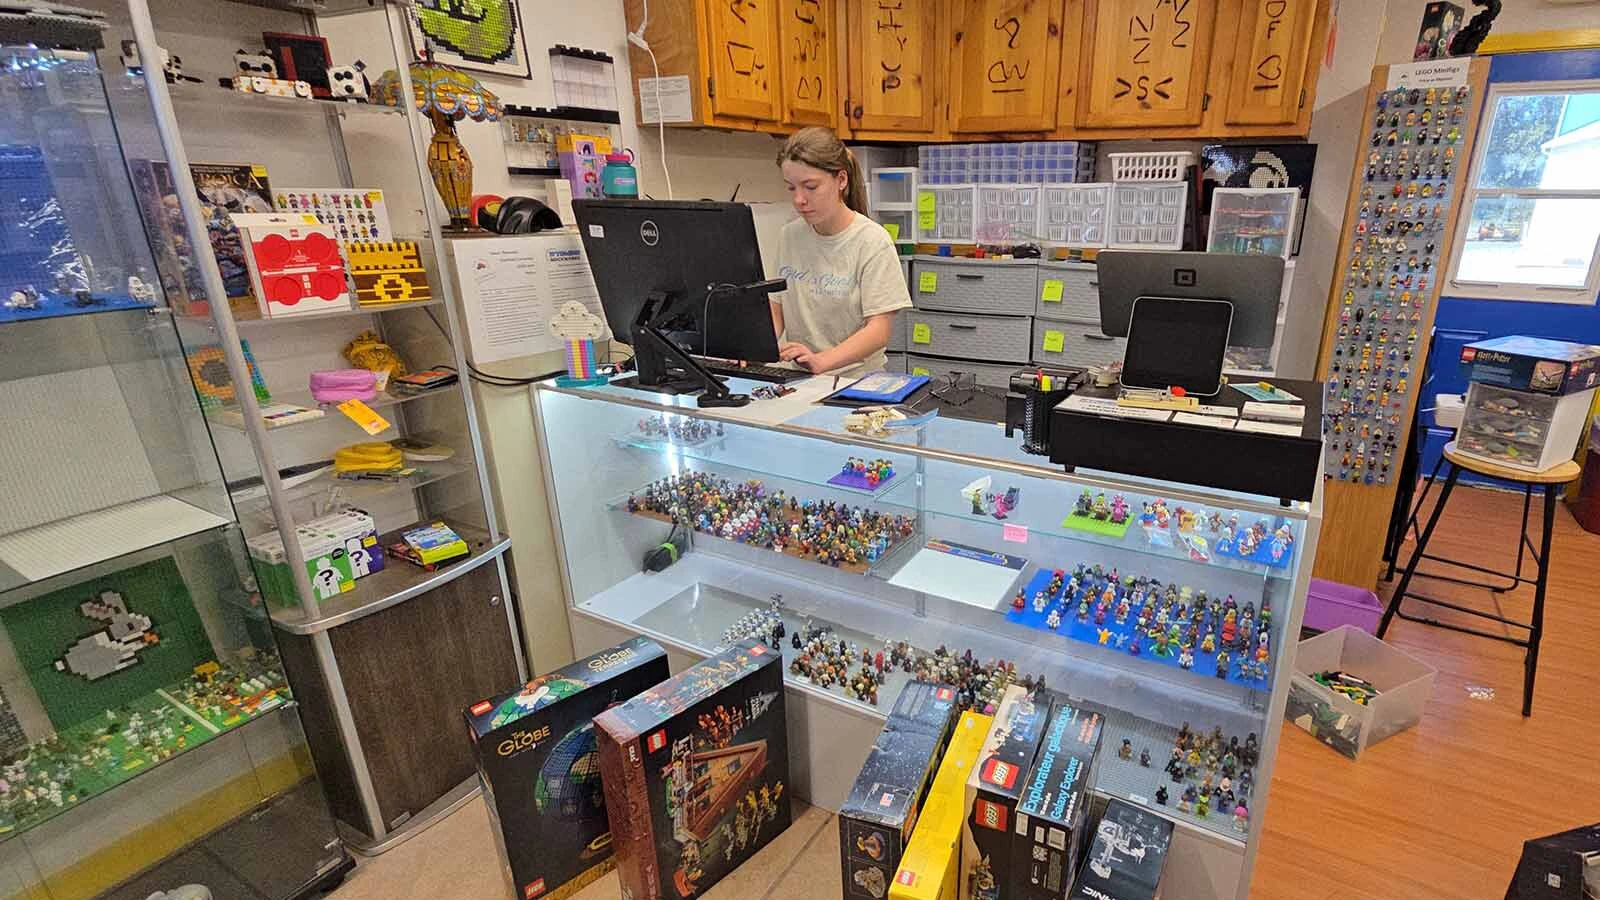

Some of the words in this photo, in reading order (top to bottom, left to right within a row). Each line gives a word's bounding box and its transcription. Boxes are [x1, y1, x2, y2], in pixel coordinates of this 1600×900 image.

[497, 725, 551, 756] GLOBE
[1023, 751, 1055, 812] Explorateur
[1050, 789, 1070, 820] Galaxy
[1060, 756, 1079, 790] Explorer
